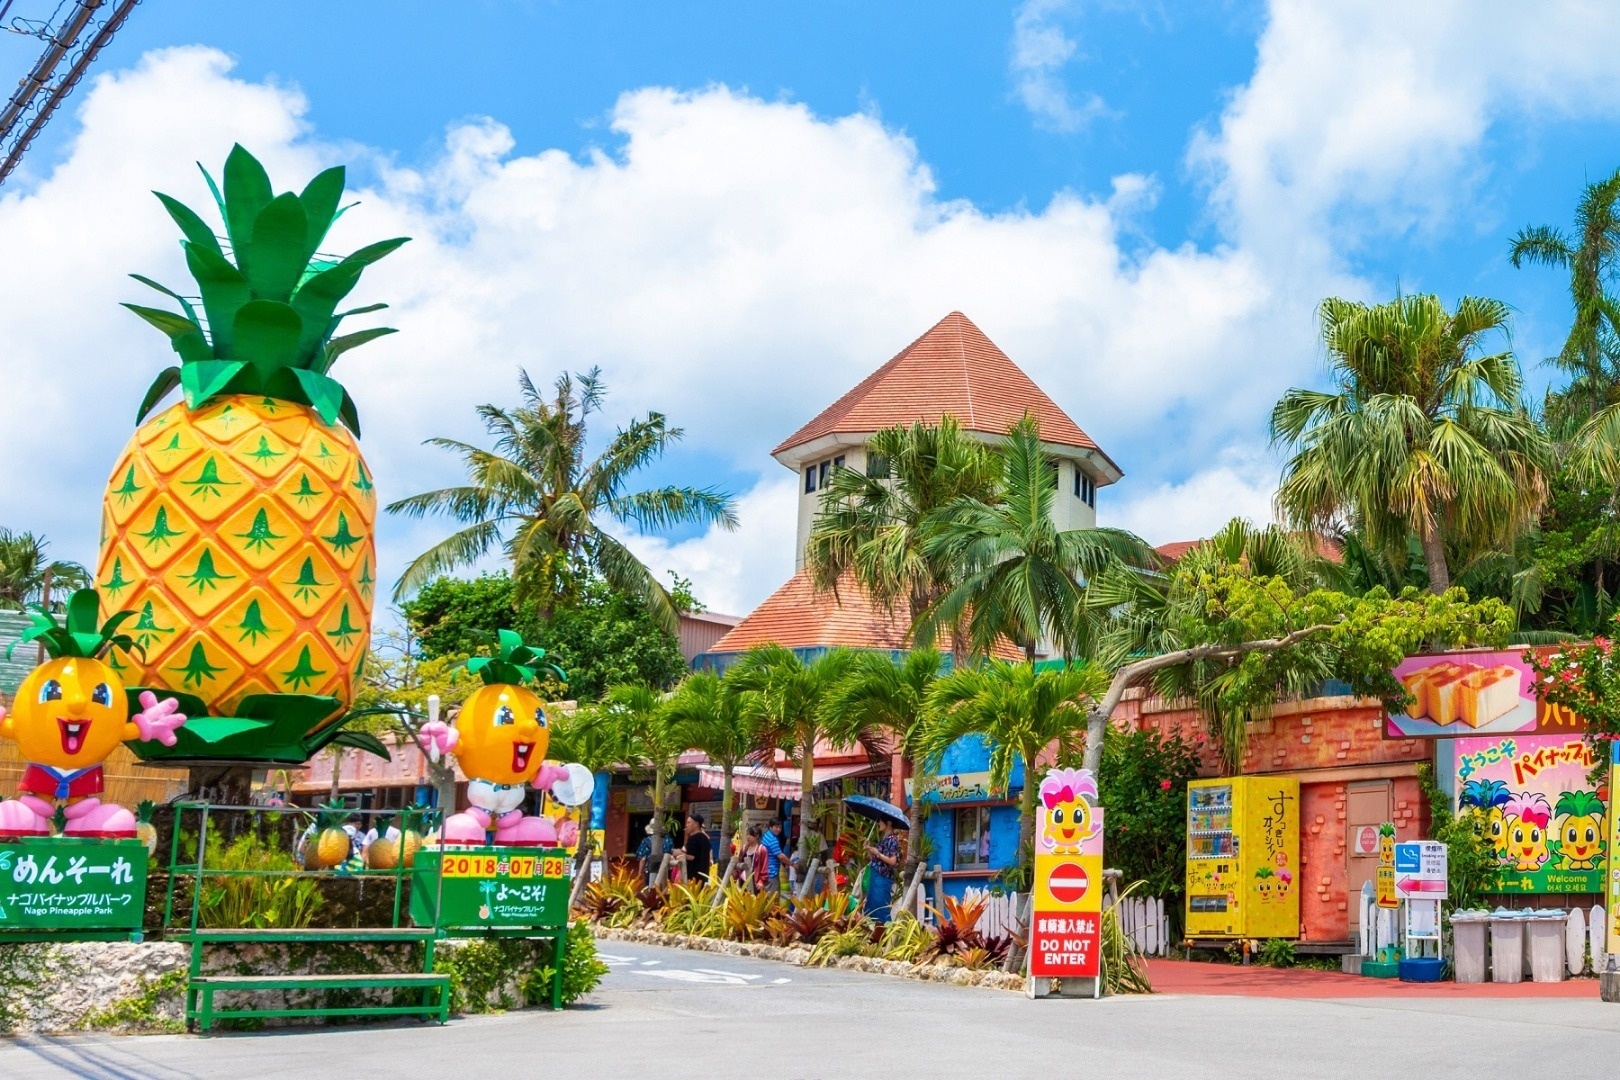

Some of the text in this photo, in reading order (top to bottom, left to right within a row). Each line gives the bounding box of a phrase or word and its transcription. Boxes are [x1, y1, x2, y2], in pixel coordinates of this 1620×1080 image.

[1459, 740, 1516, 778] ようこそ
[1513, 743, 1597, 785] パイナップル
[13, 854, 133, 885] めんそーれ
[1547, 874, 1588, 883] Welcome
[24, 906, 113, 916] Nago Pineapple Park
[1040, 939, 1091, 951] DO NOT
[1044, 953, 1086, 965] ENTER
